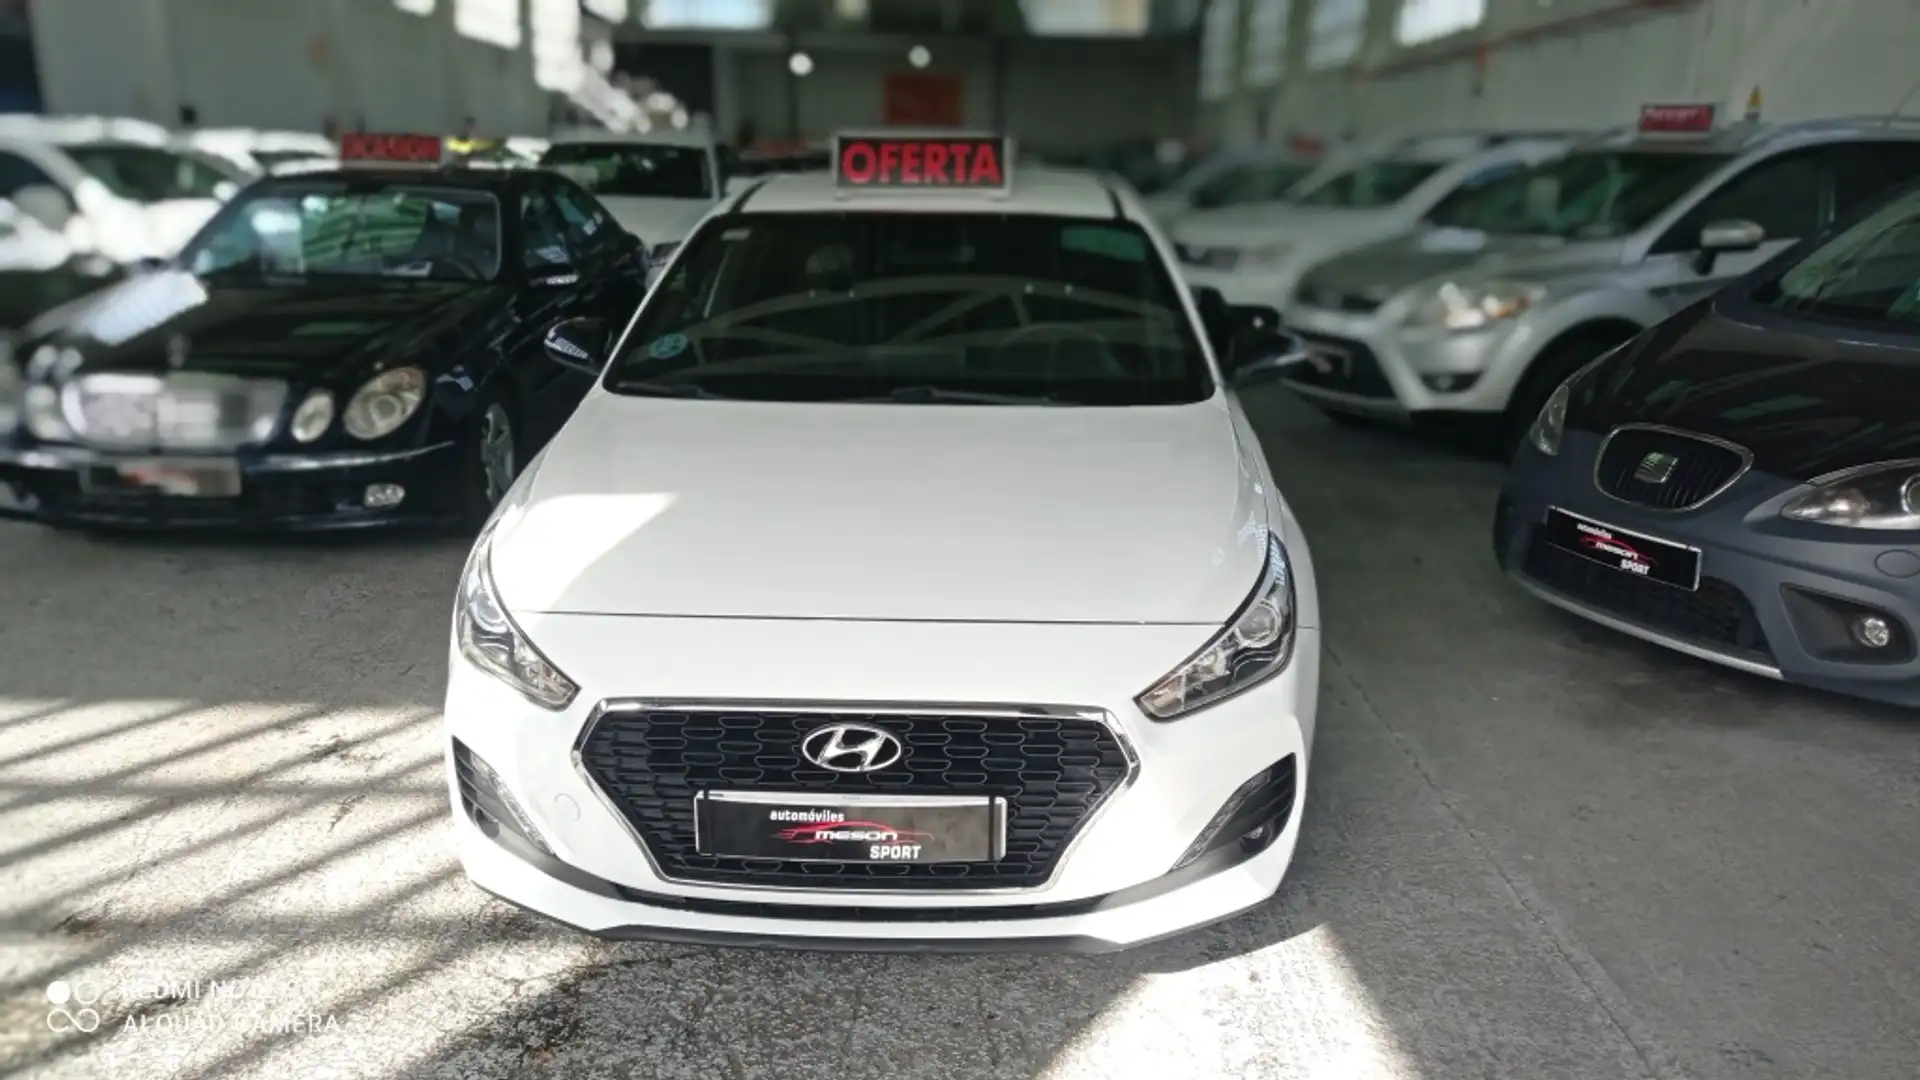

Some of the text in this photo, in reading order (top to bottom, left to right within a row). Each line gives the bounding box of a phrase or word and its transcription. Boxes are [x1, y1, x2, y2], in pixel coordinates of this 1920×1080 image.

[842, 141, 1003, 184] OFERTA
[1620, 558, 1651, 575] SPORT
[769, 808, 845, 822] automóviles
[869, 845, 922, 860] SPORT
